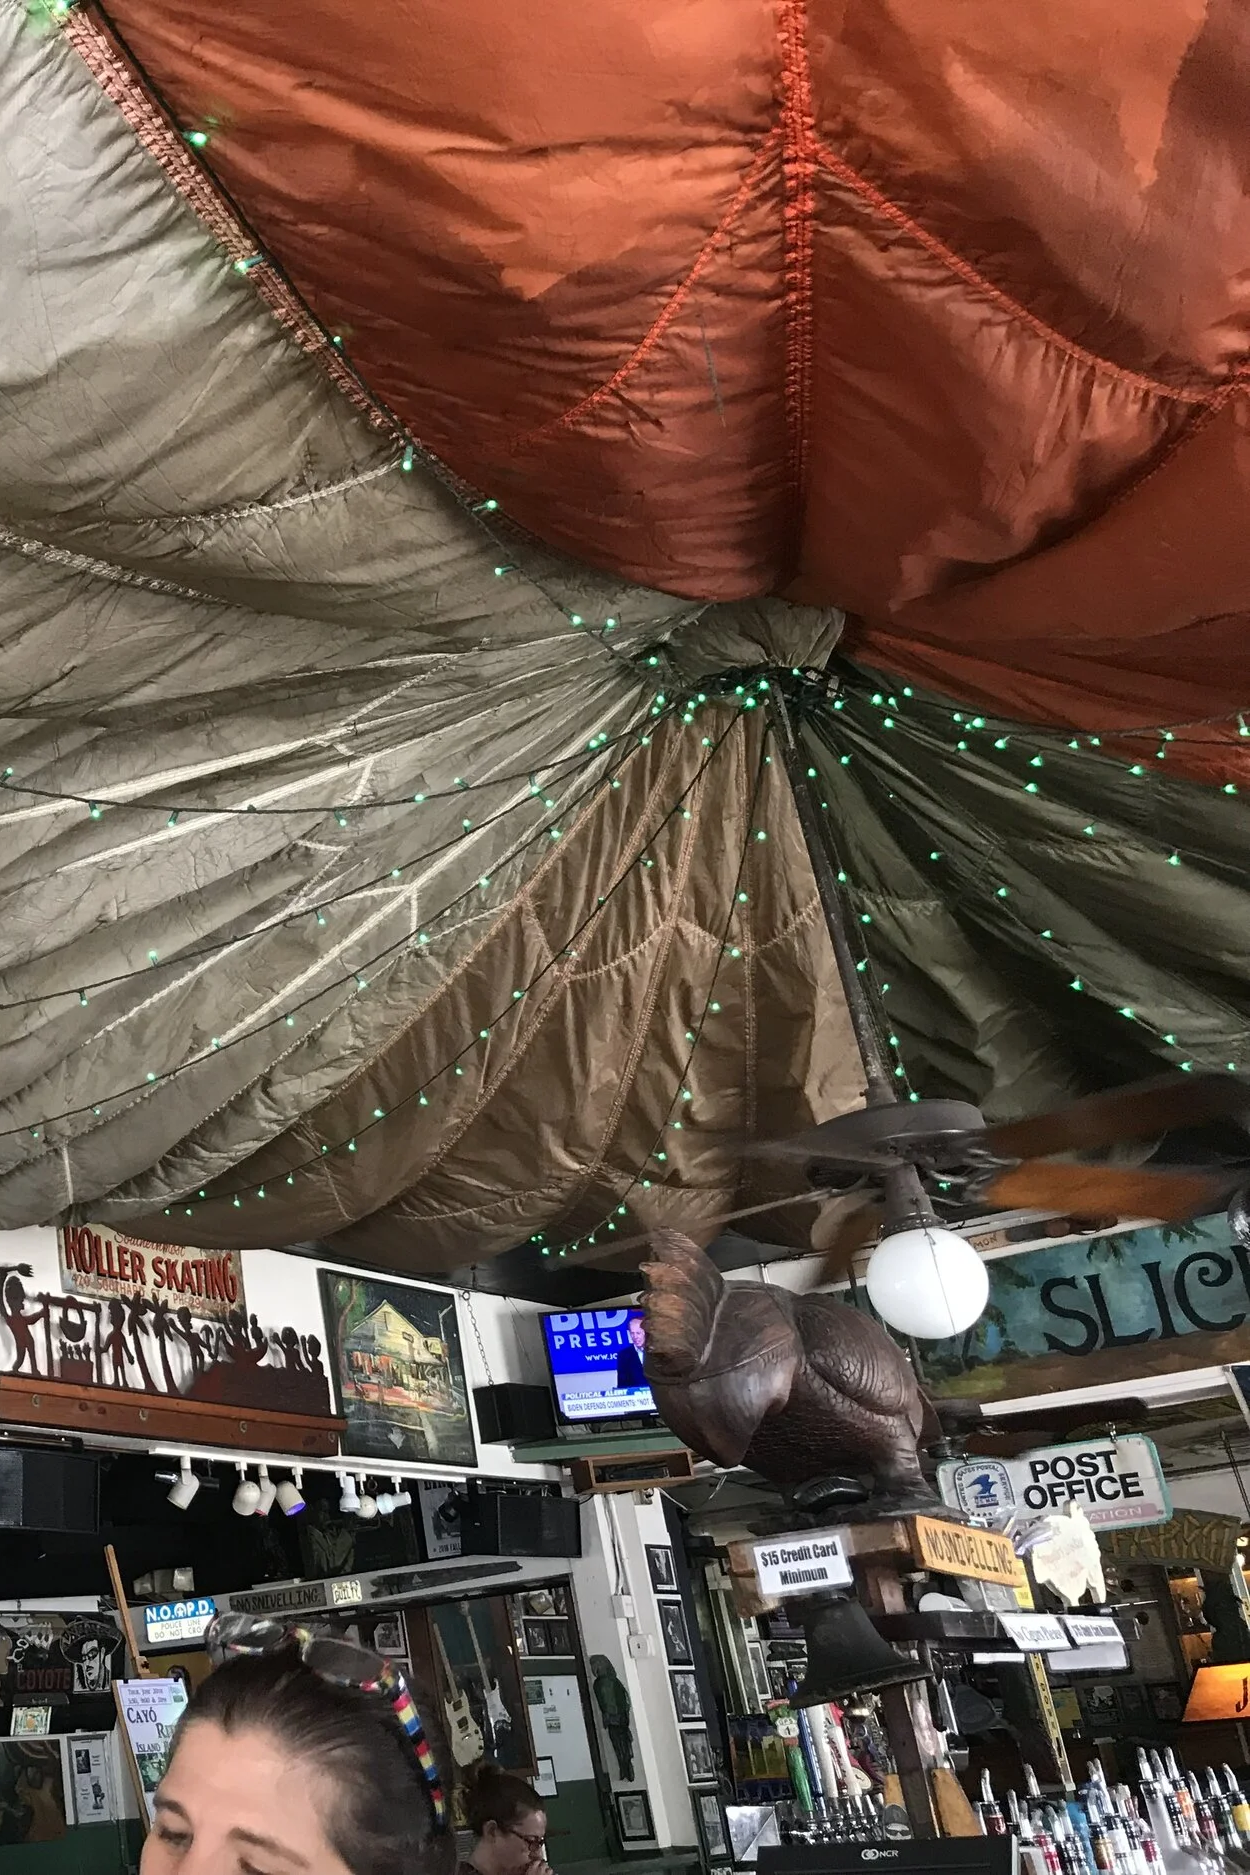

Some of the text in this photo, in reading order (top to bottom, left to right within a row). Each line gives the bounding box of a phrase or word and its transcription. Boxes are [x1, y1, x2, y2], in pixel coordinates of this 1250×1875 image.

[151, 1253, 239, 1304] SKATING
[550, 1310, 628, 1332] BID
[565, 1391, 602, 1400] POLITICAL
[605, 1389, 627, 1397] ALERT
[567, 1403, 583, 1412] BIDEN
[584, 1401, 607, 1411] DEFENDS
[1030, 1450, 1117, 1483] POST
[1023, 1472, 1145, 1510] OFFICE
[1089, 1506, 1143, 1522] ATION
[924, 1527, 944, 1560] NO
[761, 1541, 838, 1567] $15 Credit Card
[779, 1567, 828, 1586] Minimum
[154, 1625, 204, 1640] DO NOT CRO
[161, 1618, 201, 1630] POLICE LINE
[16, 1668, 72, 1690] COYOTE
[127, 1707, 157, 1723] CAYÓ
[136, 1742, 161, 1753] ISLAND
[879, 1849, 899, 1857] NCR
